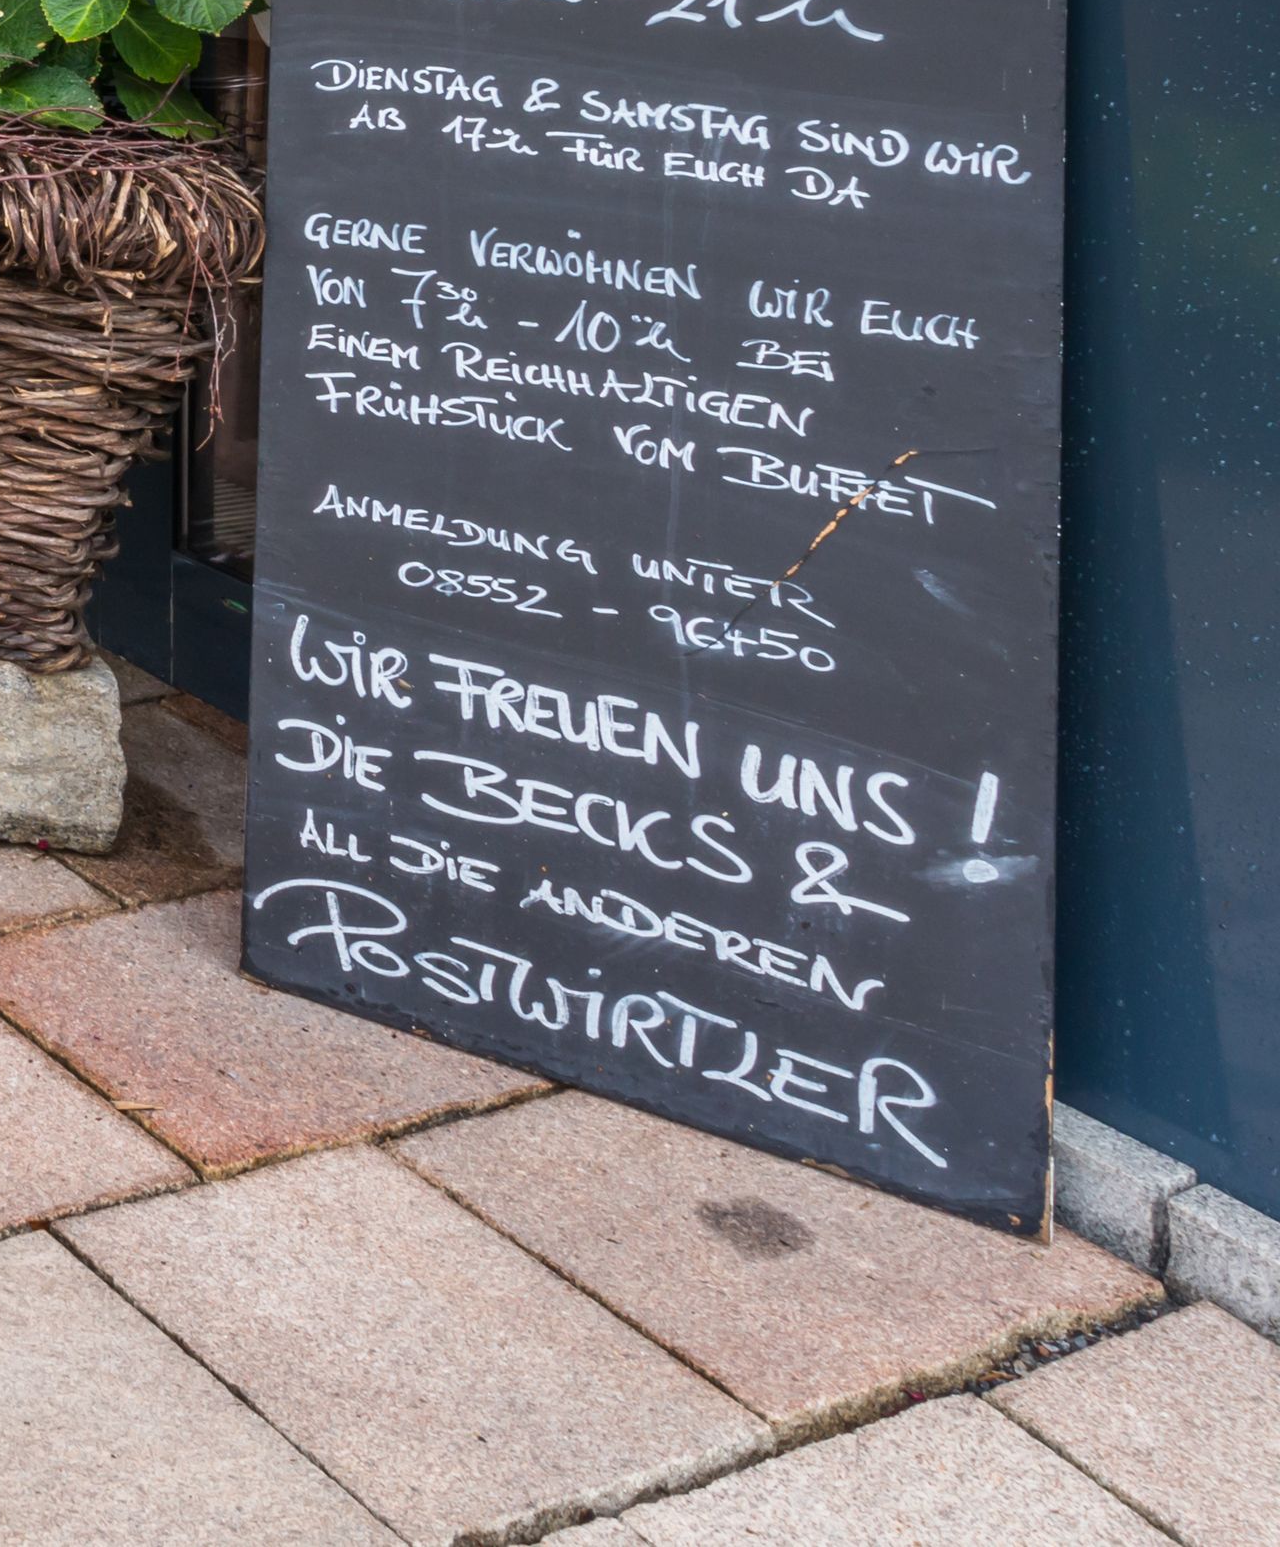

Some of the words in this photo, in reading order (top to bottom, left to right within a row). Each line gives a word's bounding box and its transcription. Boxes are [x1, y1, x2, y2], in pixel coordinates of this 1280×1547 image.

[310, 58, 504, 109] DIENSTAG
[522, 77, 562, 113] &
[579, 90, 772, 151] SAMSTAG
[796, 118, 911, 168] SIND
[923, 140, 1033, 185] WIR
[348, 100, 407, 131] AB
[544, 130, 645, 173] FÜR
[663, 151, 766, 189] EUCH
[784, 164, 872, 210] DA
[303, 211, 429, 255] GERNE
[469, 226, 703, 300] VERWÖHNEN
[747, 277, 834, 329] WIR
[859, 299, 981, 350] EUCH
[305, 264, 368, 309] VON
[734, 338, 836, 383] BEI
[304, 370, 574, 453] FRÜHSTÜCK
[612, 422, 697, 474] VOM
[715, 445, 998, 526] BUFFET
[306, 322, 422, 371] EINEM
[440, 340, 816, 438] REICHHALTIGEN
[312, 483, 599, 576] ANMELDUNG
[632, 552, 837, 629] UNTER
[396, 560, 564, 619] 08552
[647, 603, 837, 673] 96450
[288, 613, 414, 710] WIR
[428, 652, 703, 780] FREUEN
[739, 743, 917, 847] UNS
[274, 713, 393, 793] DIE
[413, 749, 754, 885] BECKS
[789, 839, 912, 924] &
[298, 807, 373, 864] ALL
[389, 833, 502, 893] DIE
[519, 878, 886, 1012] ANDEREN
[252, 877, 949, 1170] POSTWIRTLER
